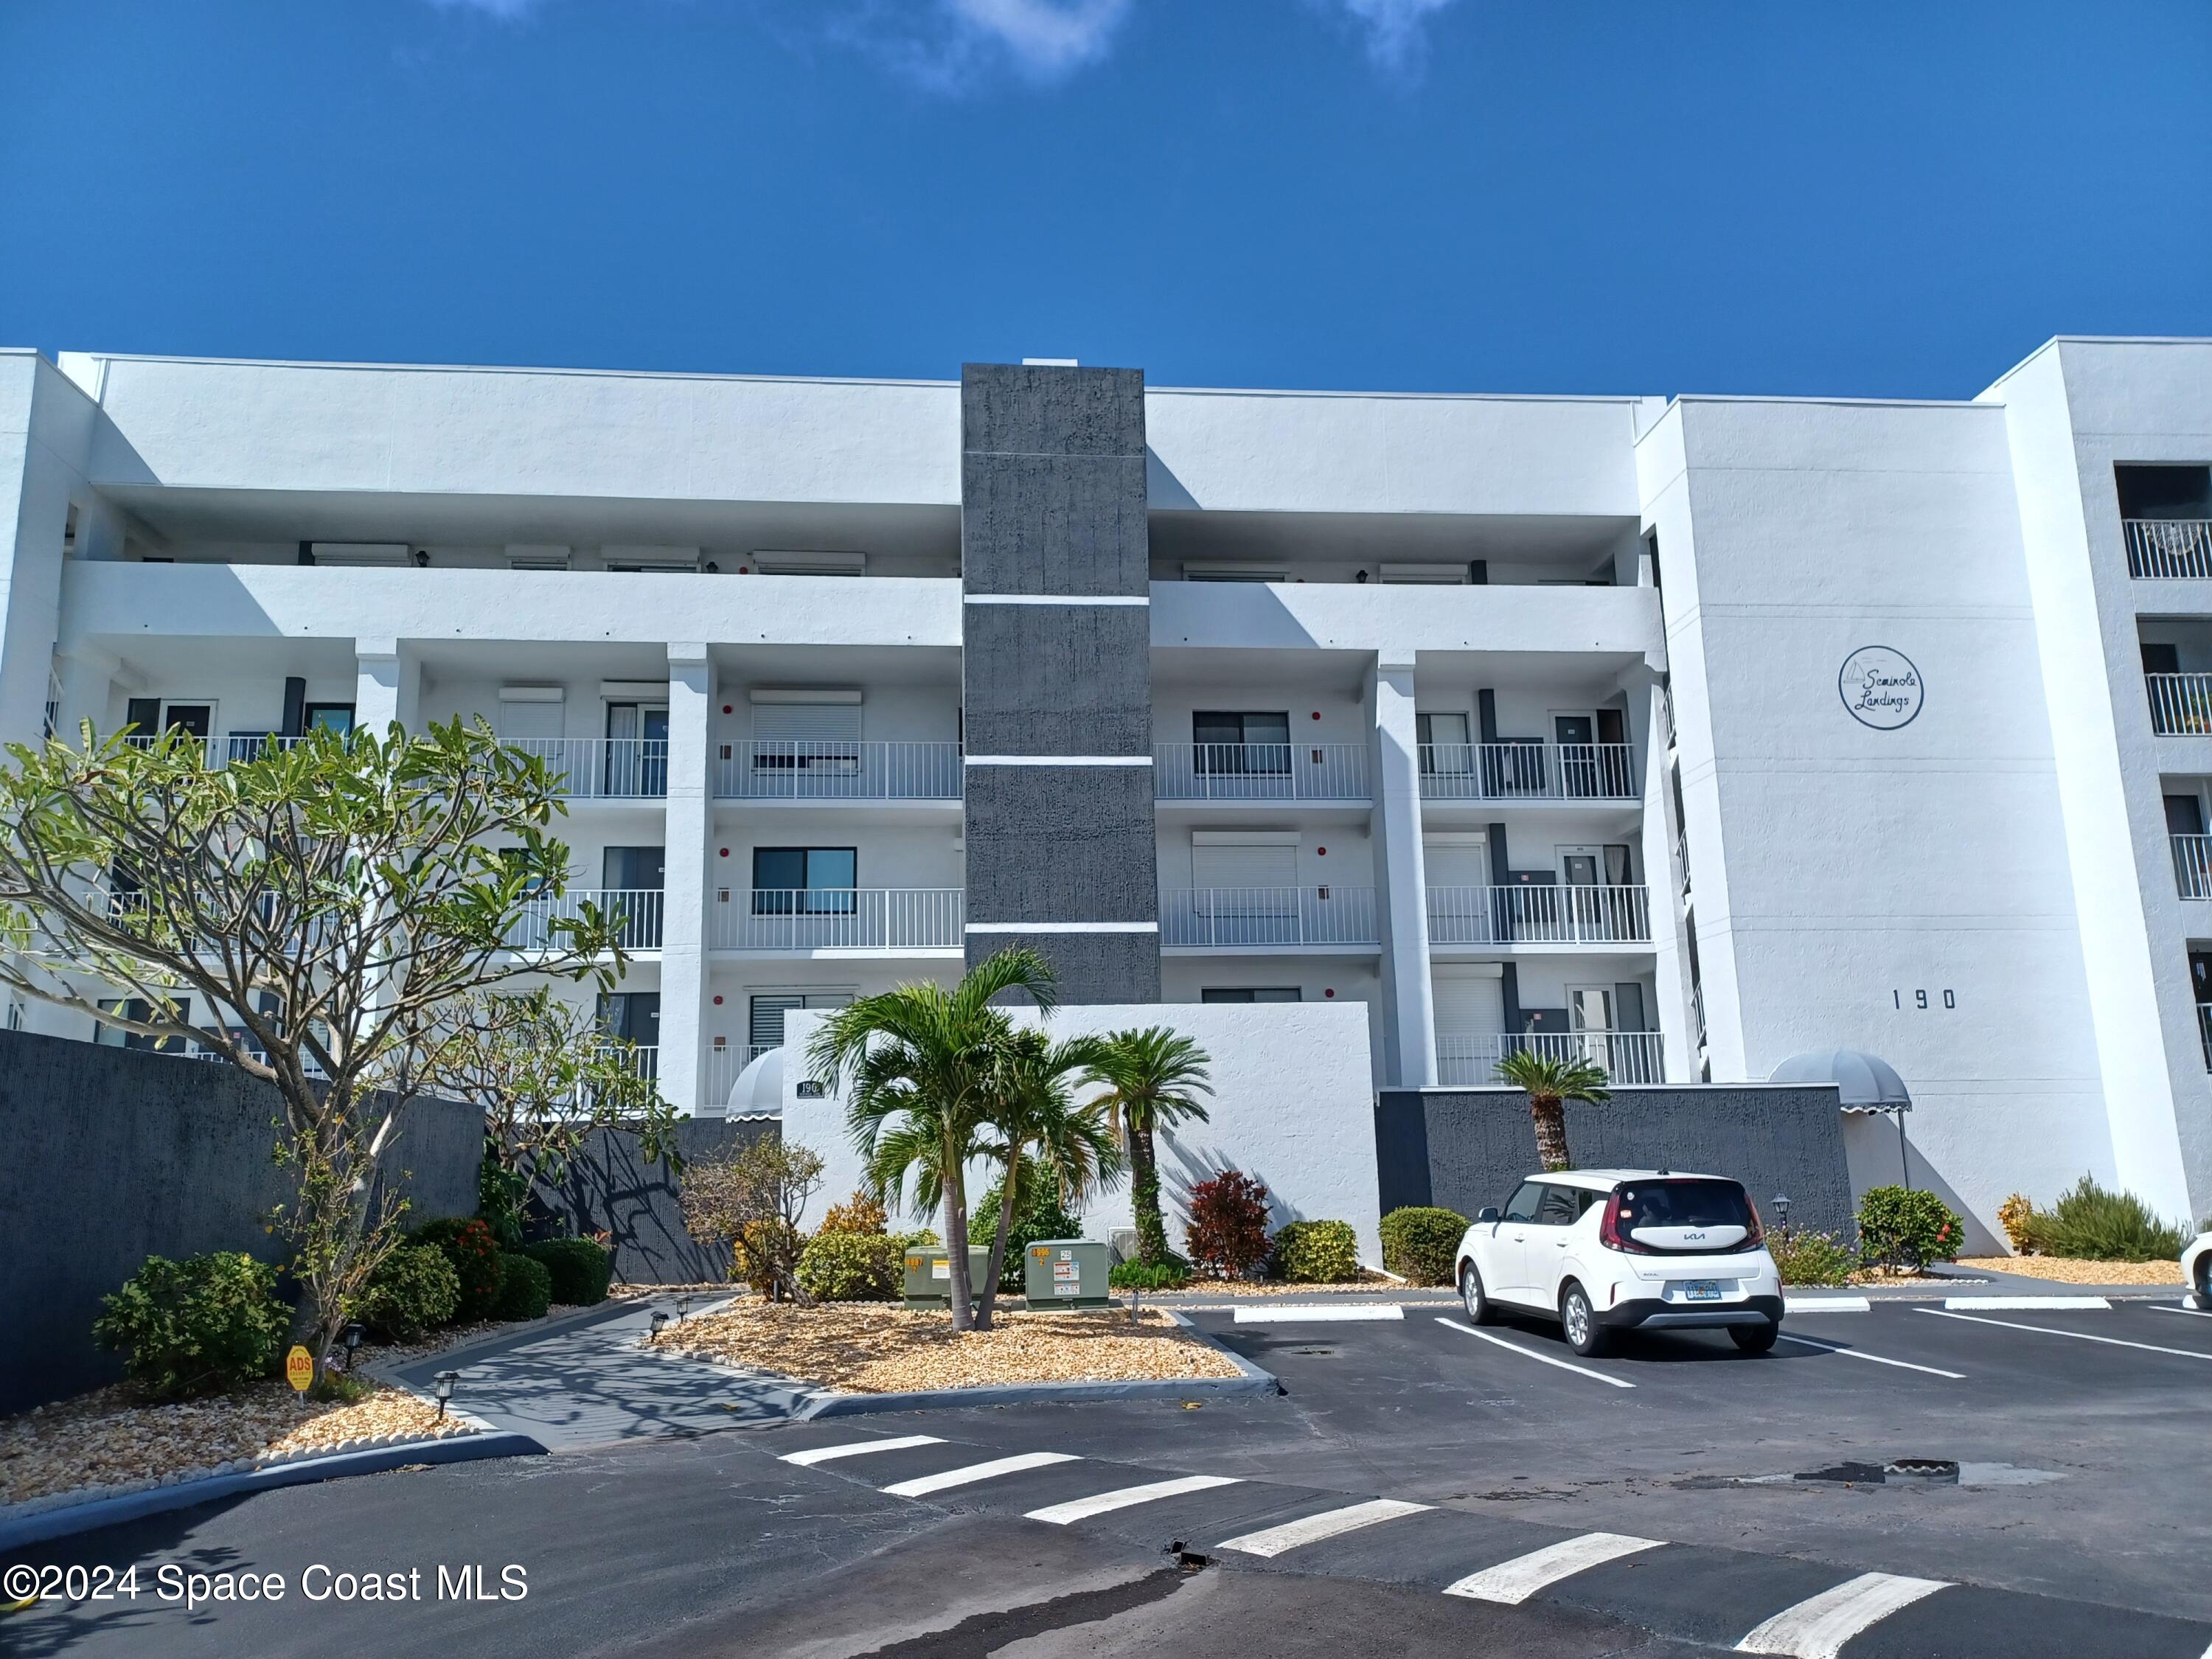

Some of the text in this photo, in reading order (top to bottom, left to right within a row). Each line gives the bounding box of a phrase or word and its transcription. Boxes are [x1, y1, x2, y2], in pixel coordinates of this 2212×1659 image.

[1863, 669, 1916, 689] Seminole
[1854, 691, 1910, 712] Landings
[1891, 990, 1955, 1009] 190
[802, 1082, 817, 1093] 190
[290, 1357, 310, 1371] ADS
